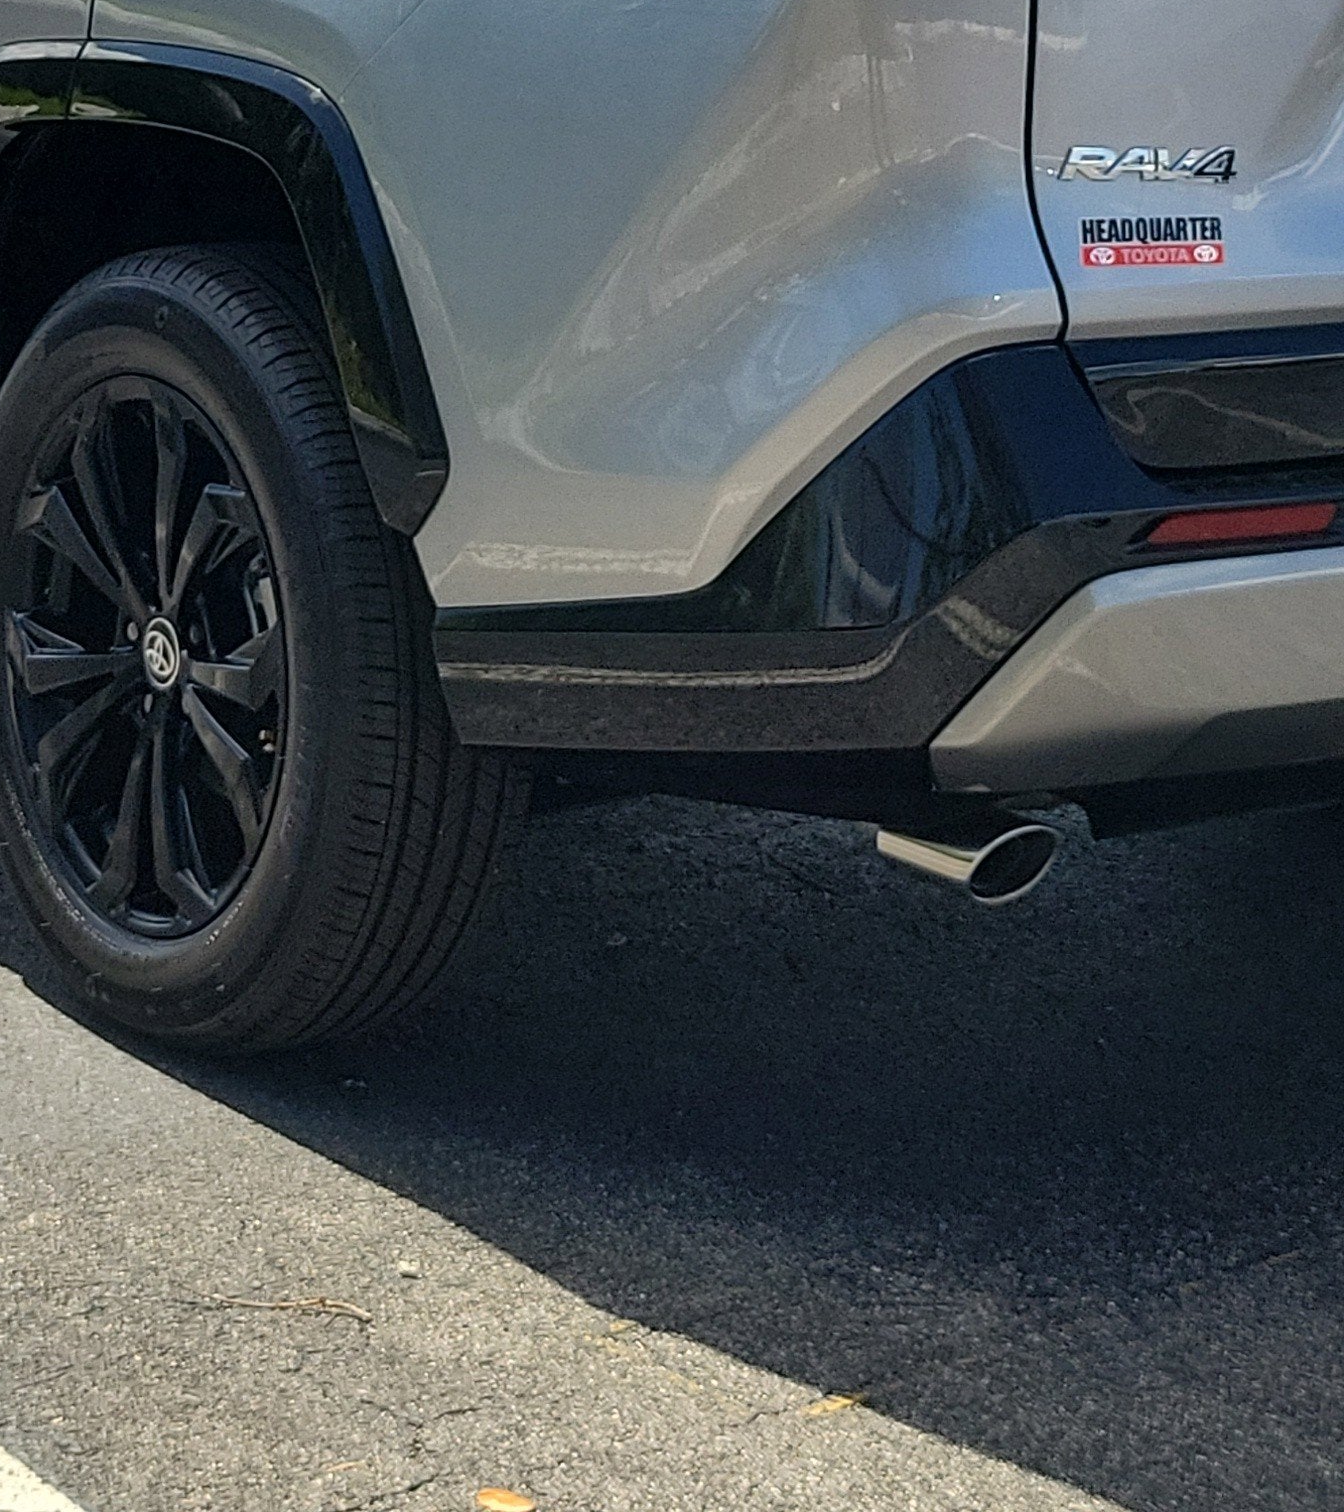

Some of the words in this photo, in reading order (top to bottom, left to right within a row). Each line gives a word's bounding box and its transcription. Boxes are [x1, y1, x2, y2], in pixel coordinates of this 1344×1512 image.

[1057, 144, 1237, 184] RAV4
[1081, 217, 1222, 244] HEADQUARTER
[1120, 247, 1190, 263] TOYOTA
